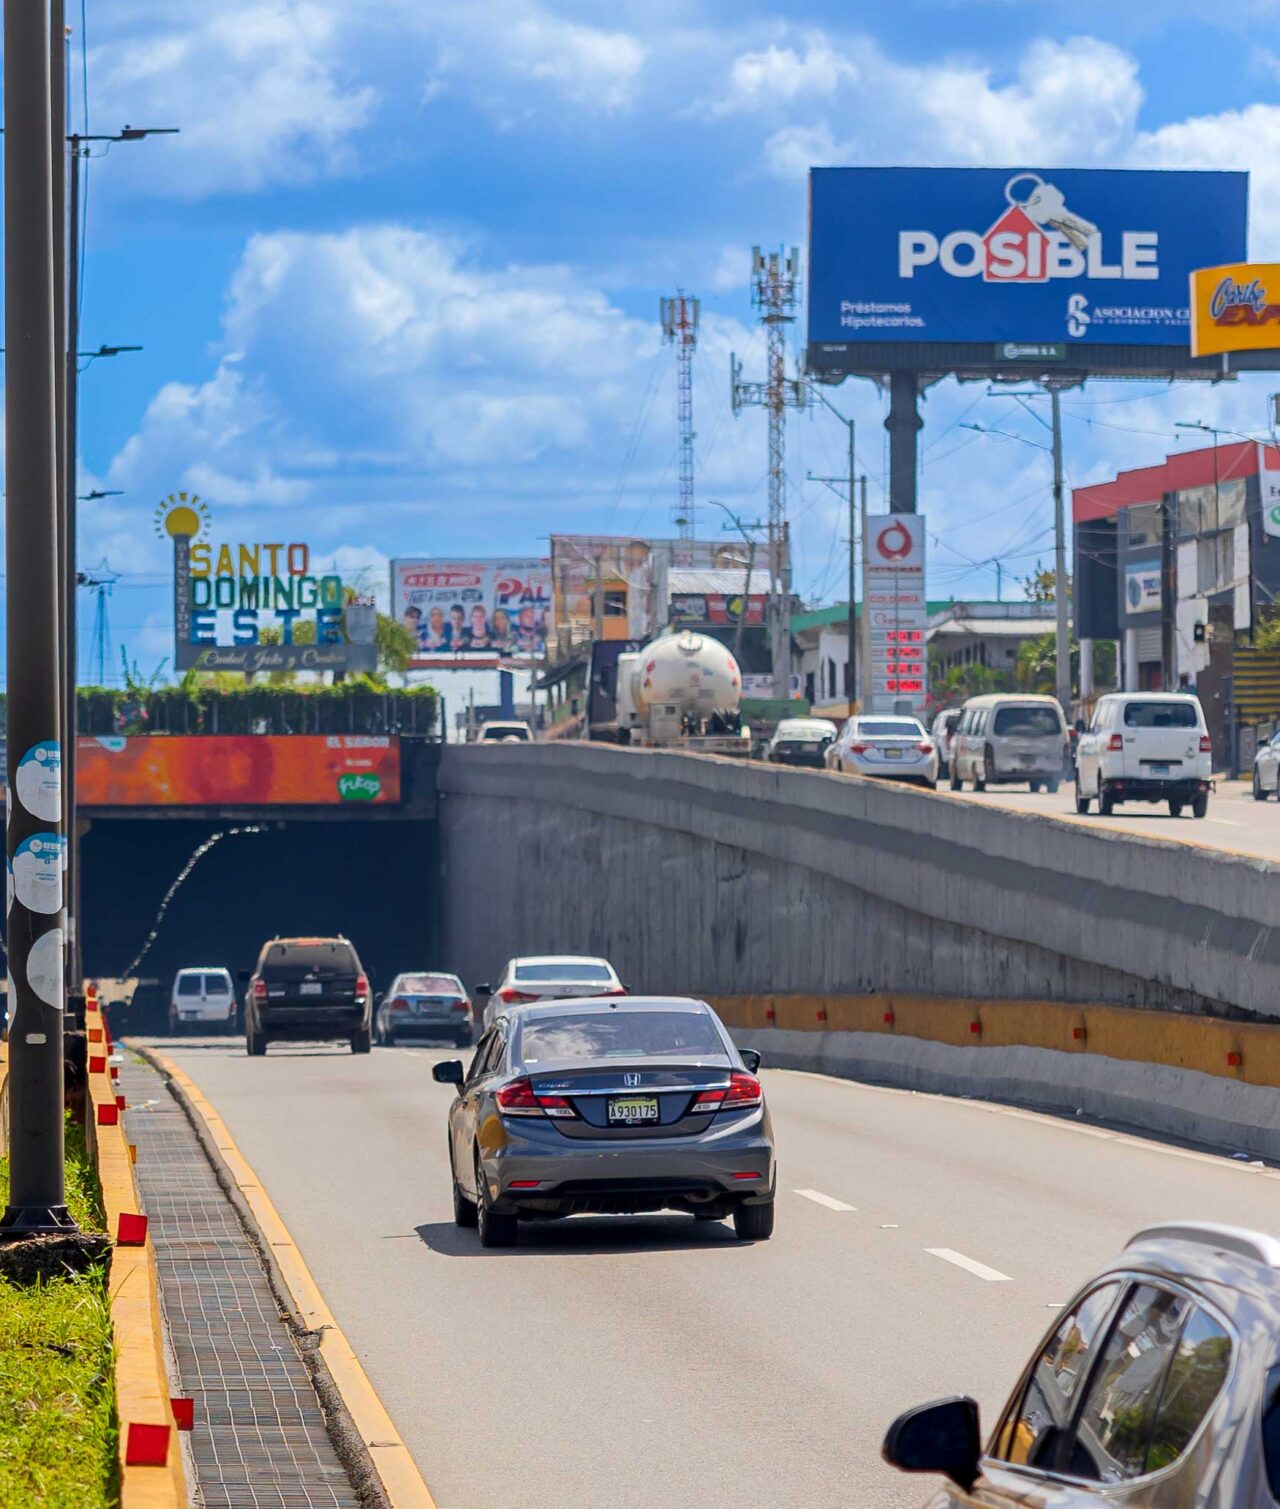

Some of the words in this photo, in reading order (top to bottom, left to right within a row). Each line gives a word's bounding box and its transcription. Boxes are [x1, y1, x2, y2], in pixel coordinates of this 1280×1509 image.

[898, 230, 1159, 280] POSIBLE
[190, 543, 309, 577] SANTO
[192, 575, 343, 610] DOMINGO
[191, 608, 344, 646] ESTE
[610, 1104, 657, 1118] A930175
